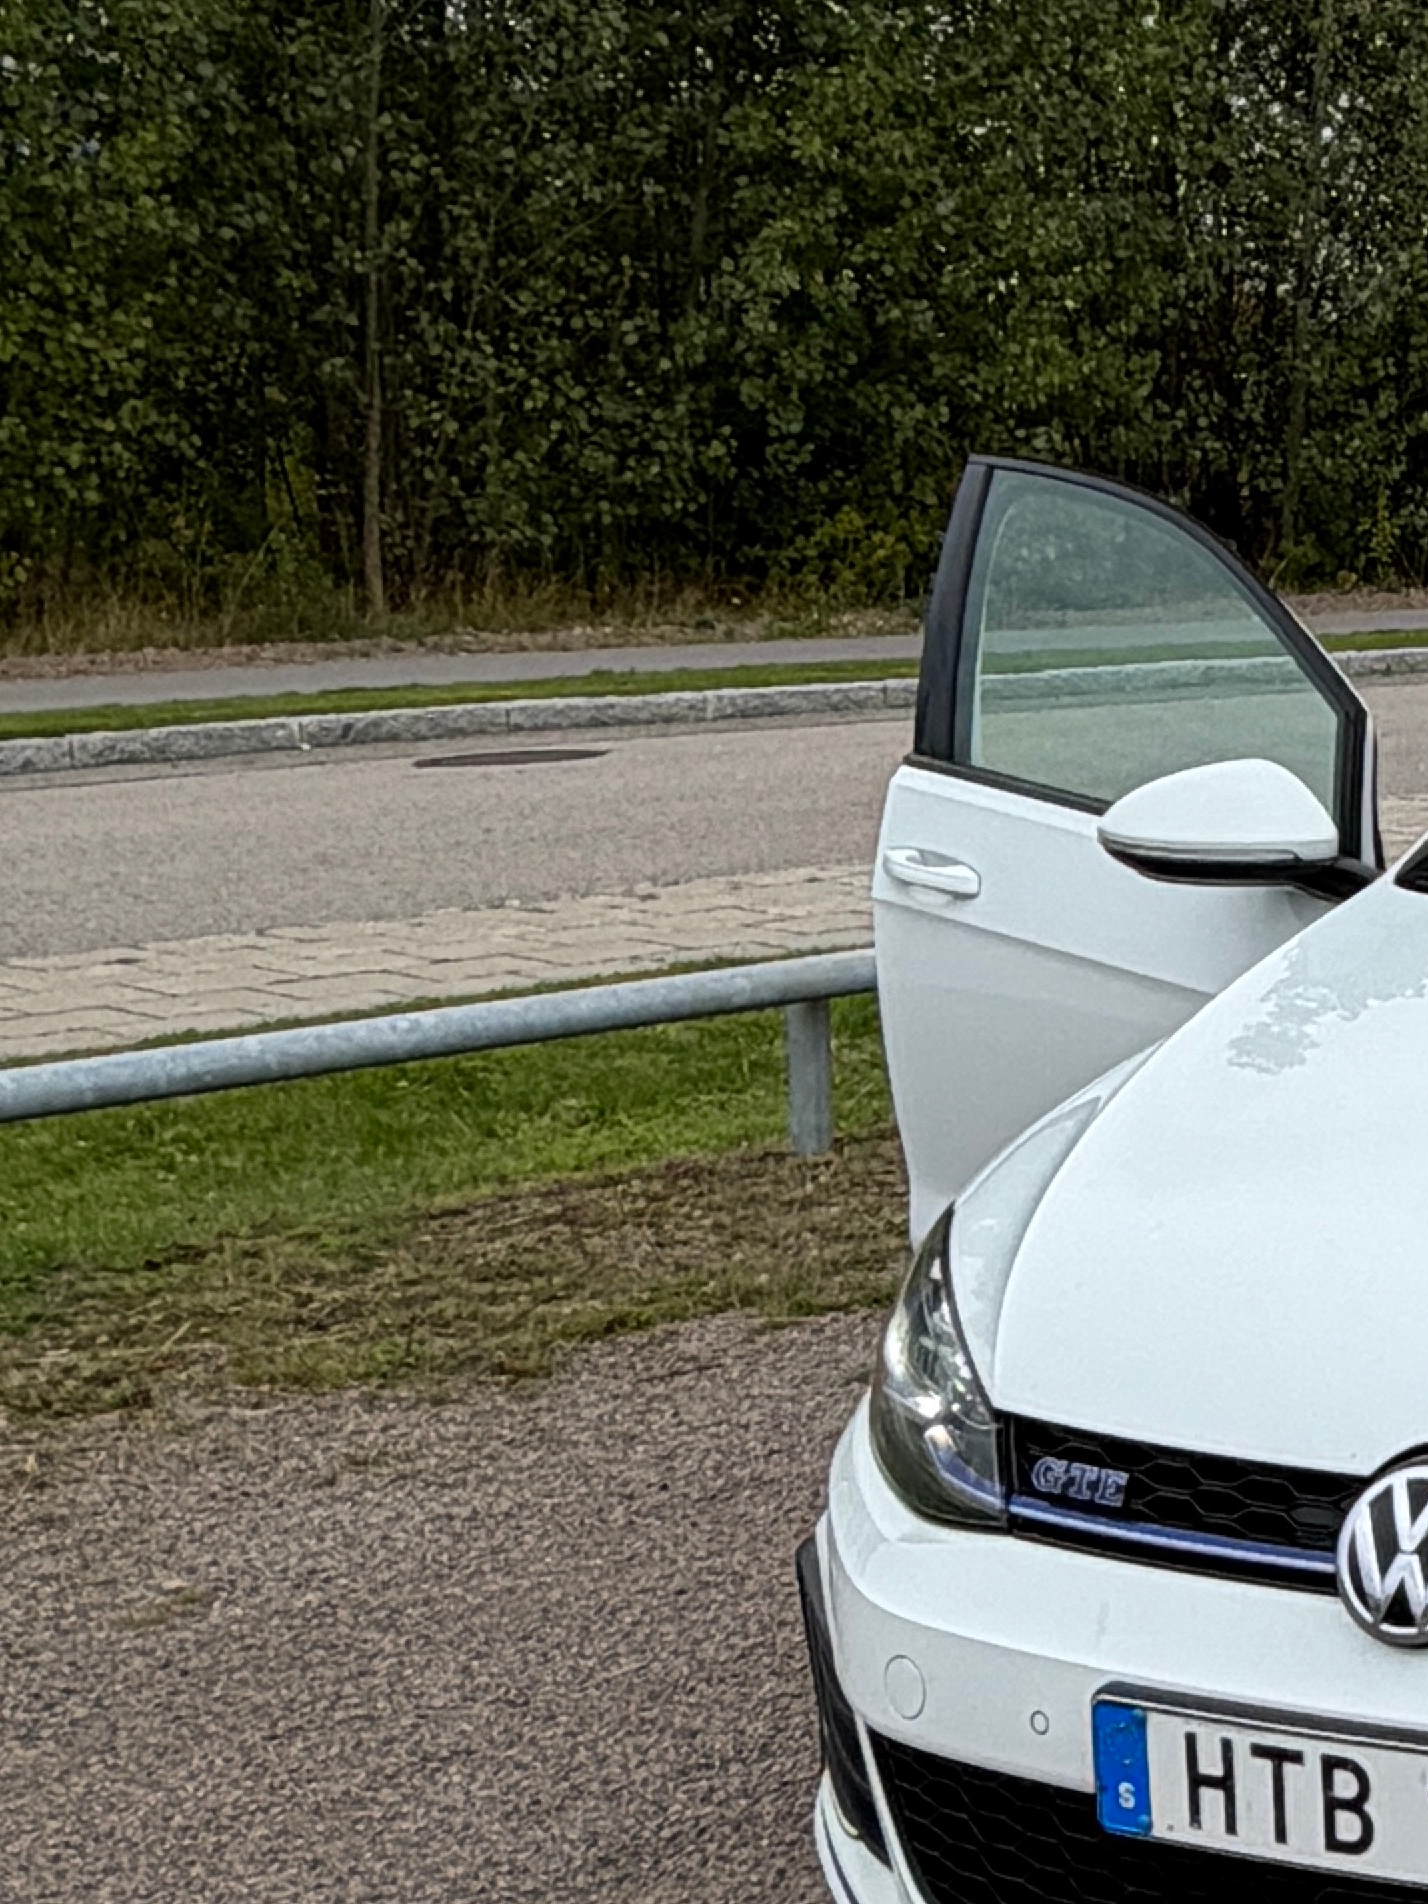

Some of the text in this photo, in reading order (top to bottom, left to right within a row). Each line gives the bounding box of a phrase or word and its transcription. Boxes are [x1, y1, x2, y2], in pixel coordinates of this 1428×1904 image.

[1031, 1456, 1130, 1507] GTE
[1118, 1781, 1136, 1809] S
[1184, 1731, 1375, 1856] HTB
